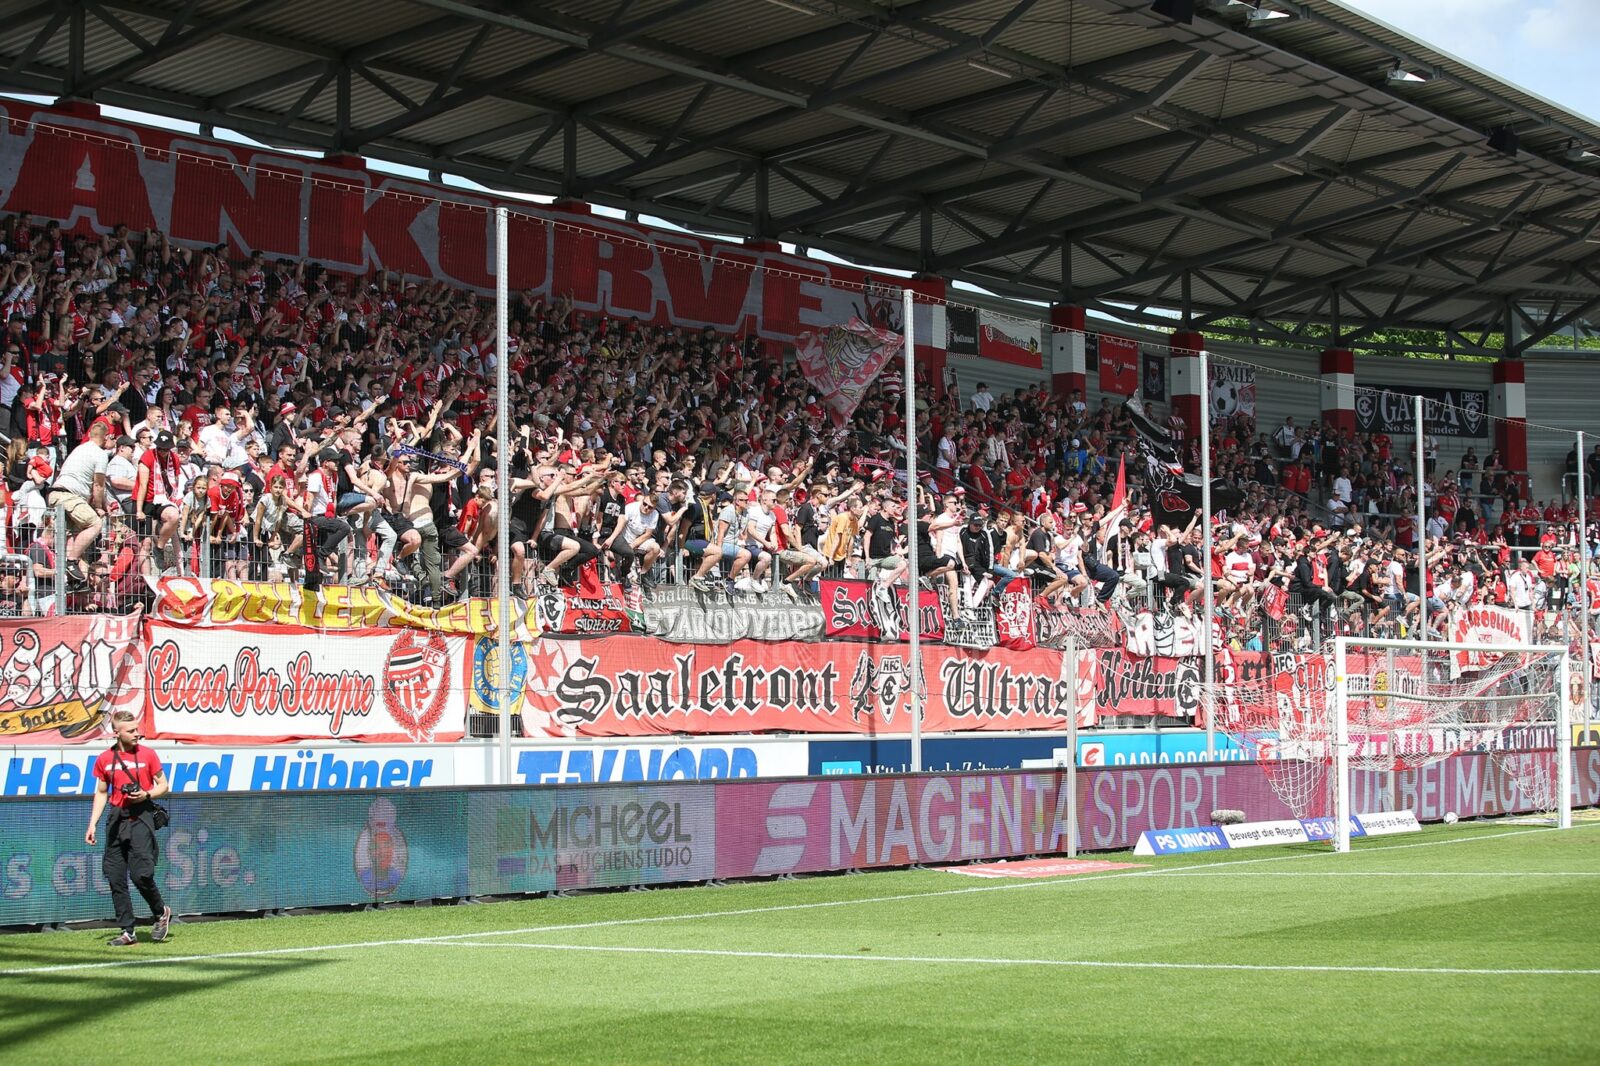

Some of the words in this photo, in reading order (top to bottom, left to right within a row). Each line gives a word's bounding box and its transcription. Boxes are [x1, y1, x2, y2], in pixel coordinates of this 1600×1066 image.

[0, 106, 832, 343] ANKURVE
[1402, 424, 1460, 434] Sunder
[883, 660, 900, 672] HFC
[1098, 651, 1176, 707] Köthen
[1296, 659, 1337, 692] CHAO
[149, 640, 228, 713] Coesa
[230, 646, 281, 717] Per
[281, 650, 375, 735] Sempre
[556, 650, 840, 724] Saalefront
[941, 656, 1068, 719] Ultras
[251, 749, 433, 790] Hübner
[1402, 757, 1445, 819] BEI
[830, 774, 1082, 866] MAGENTA
[1093, 767, 1226, 846] SPORT
[1230, 829, 1261, 841] bewegt
[1262, 828, 1274, 838] die
[1275, 826, 1303, 839] Region
[1306, 821, 1323, 836] PS
[165, 828, 256, 892] Sie.
[570, 846, 692, 872] KÜCHENSTUDIO
[1157, 835, 1178, 849] PS
[1178, 831, 1219, 848] UNION
